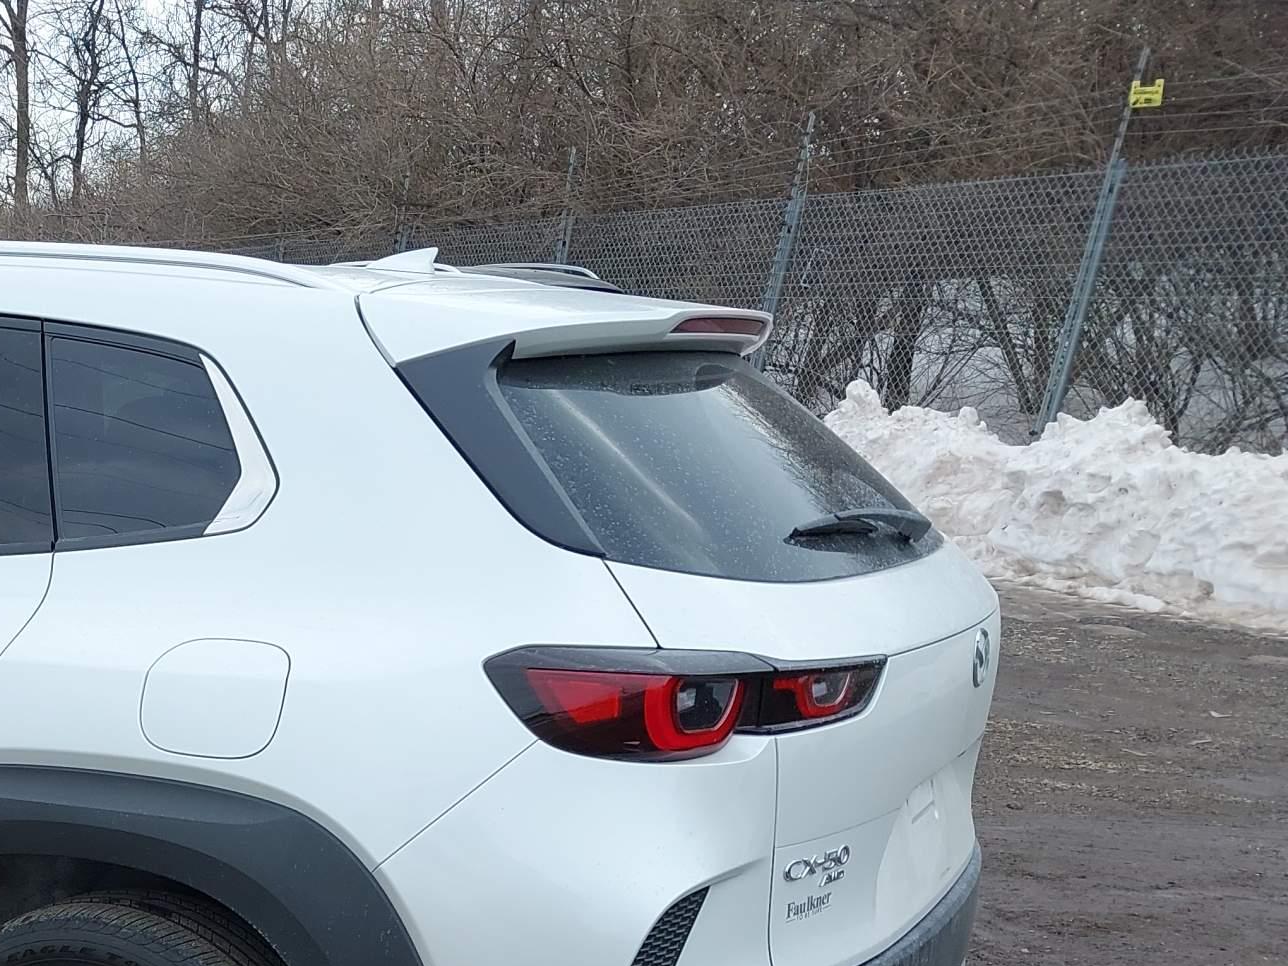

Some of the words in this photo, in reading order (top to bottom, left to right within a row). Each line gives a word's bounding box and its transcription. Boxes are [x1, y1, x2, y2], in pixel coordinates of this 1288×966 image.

[784, 845, 850, 882] CX-50
[819, 870, 845, 887] AWD
[786, 893, 832, 918] Faulkner
[6, 945, 97, 962] EAGLE
